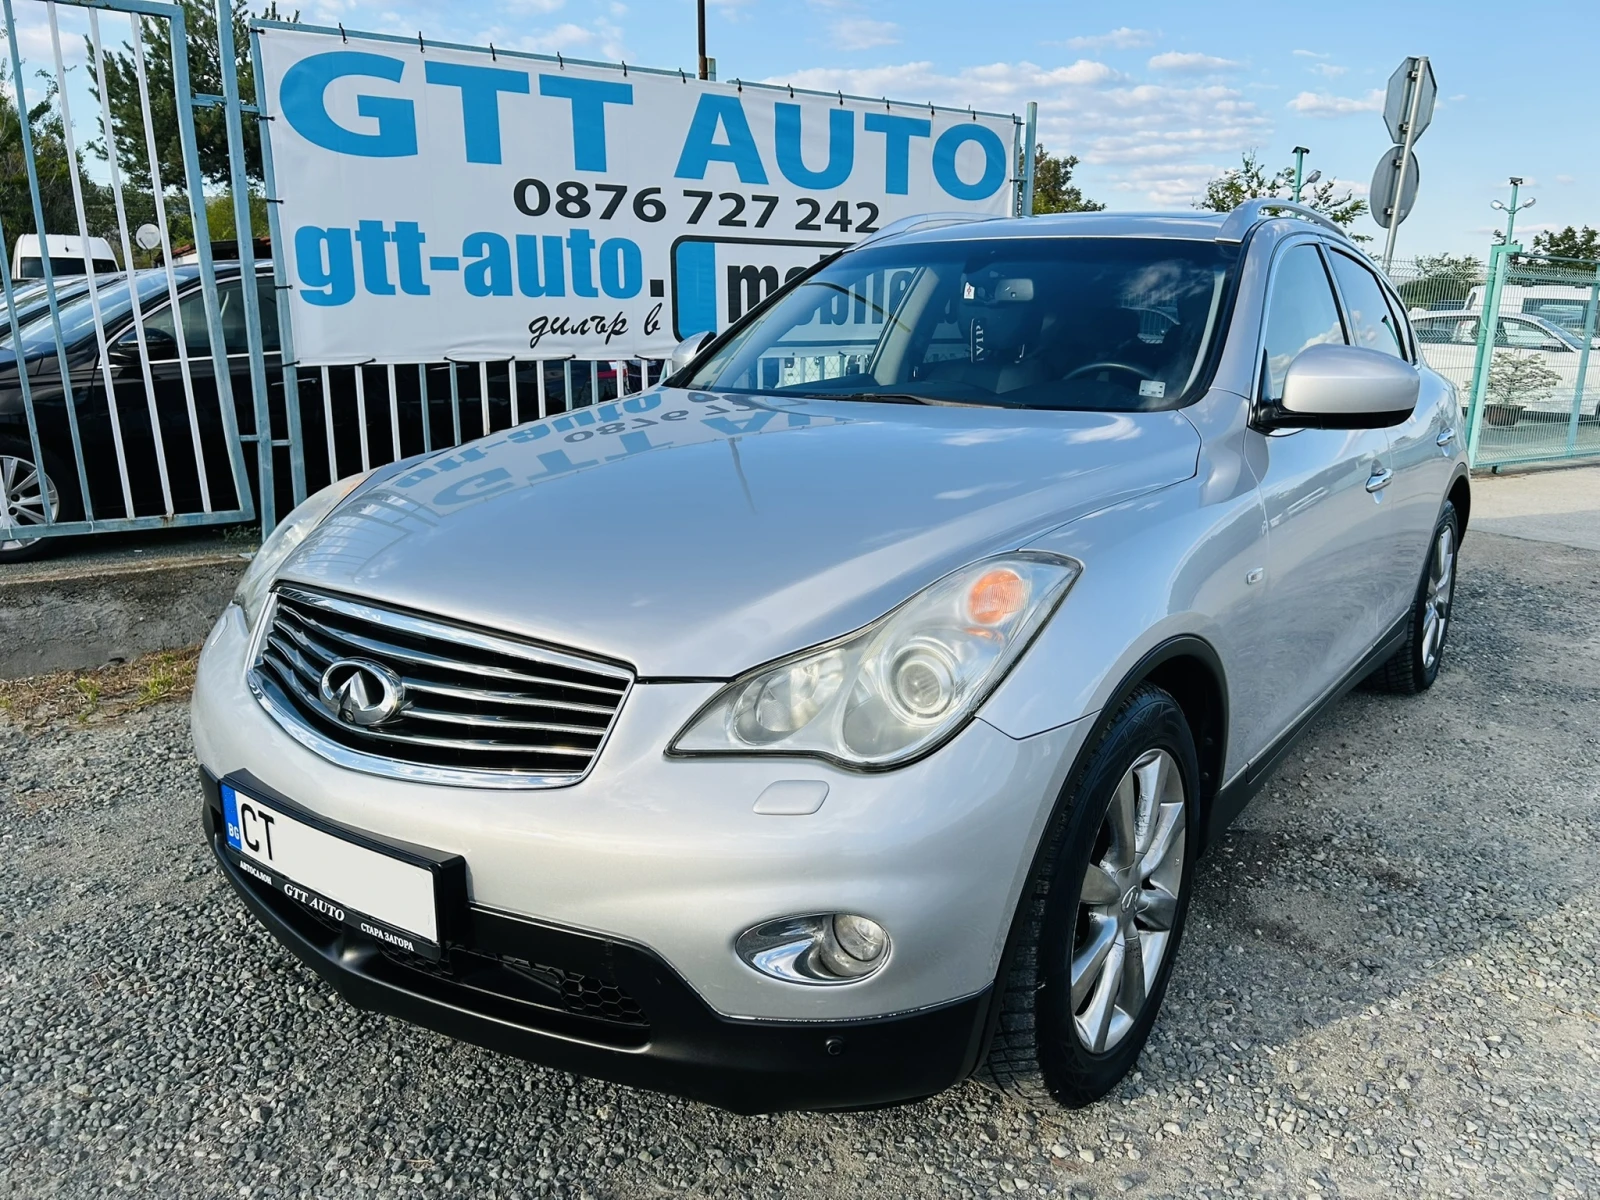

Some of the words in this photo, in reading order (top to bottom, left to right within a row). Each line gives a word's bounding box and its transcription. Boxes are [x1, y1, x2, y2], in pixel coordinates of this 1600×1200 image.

[279, 50, 634, 172] GTT
[674, 92, 1006, 201] AUTO
[513, 178, 667, 223] 0876
[682, 189, 780, 229] 727
[794, 198, 880, 234] 242
[528, 311, 629, 349] дилър
[227, 822, 240, 840] BG
[241, 803, 275, 861] CT
[284, 883, 308, 903] GTT
[309, 897, 345, 922] AUTO
[360, 922, 385, 940] СТАРА
[384, 931, 415, 952] ЗАГОРА
